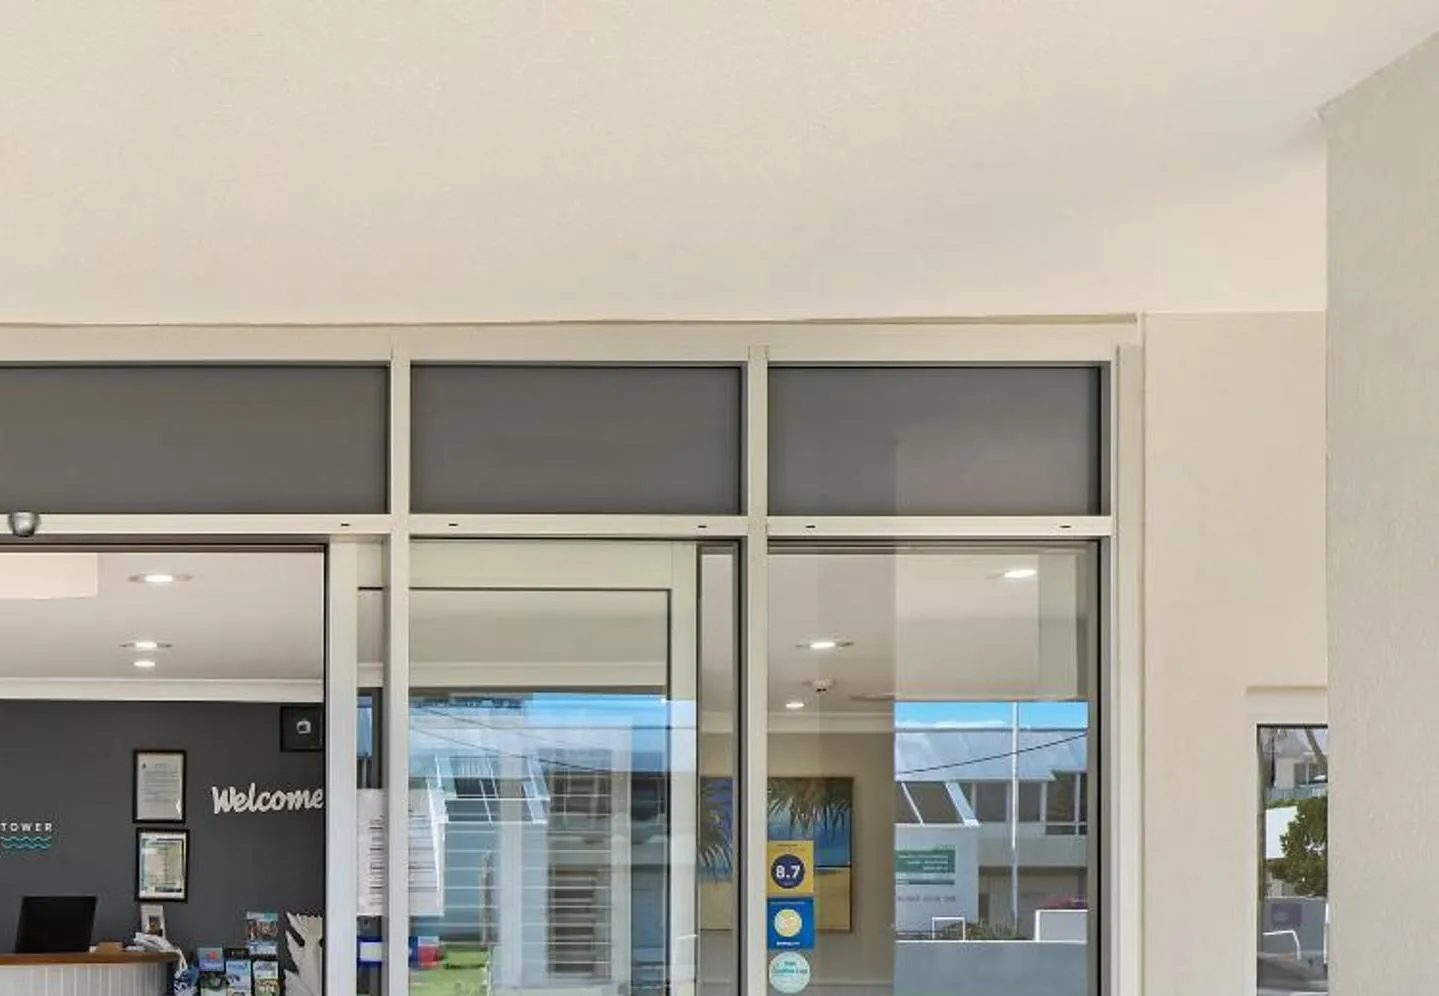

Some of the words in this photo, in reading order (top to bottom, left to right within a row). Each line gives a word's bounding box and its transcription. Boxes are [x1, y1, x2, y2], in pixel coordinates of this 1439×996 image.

[211, 782, 324, 815] Welcome
[0, 822, 53, 832] TOWER
[775, 864, 801, 880] 8.7
